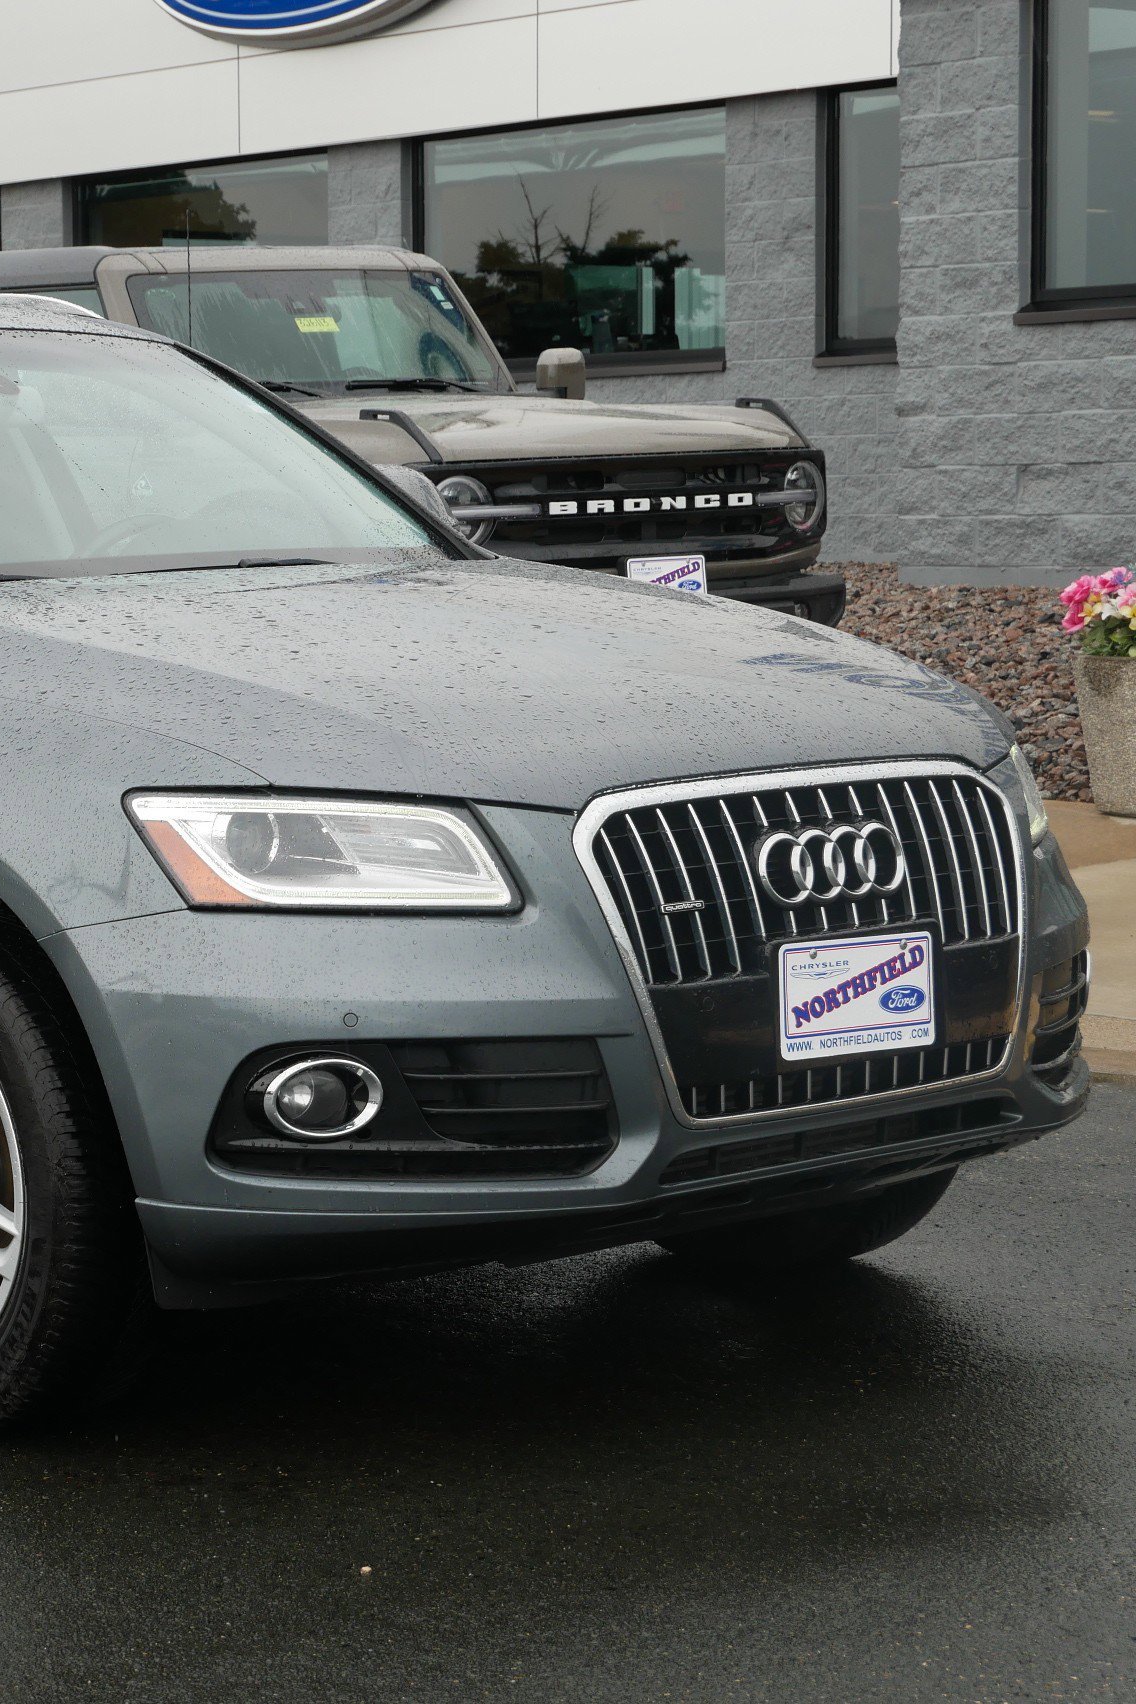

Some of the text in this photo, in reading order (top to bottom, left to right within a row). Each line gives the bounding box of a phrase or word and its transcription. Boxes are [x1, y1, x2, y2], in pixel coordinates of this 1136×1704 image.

[549, 492, 753, 515] BRONCO
[649, 561, 701, 585] THFIELD
[665, 902, 702, 912] quattro
[791, 960, 849, 971] CHRYSLER
[791, 945, 924, 1028] NORTHFIELD
[888, 989, 918, 1009] Ford
[786, 1027, 930, 1053] WWW. NORTHFIELDAUTOS .COM
